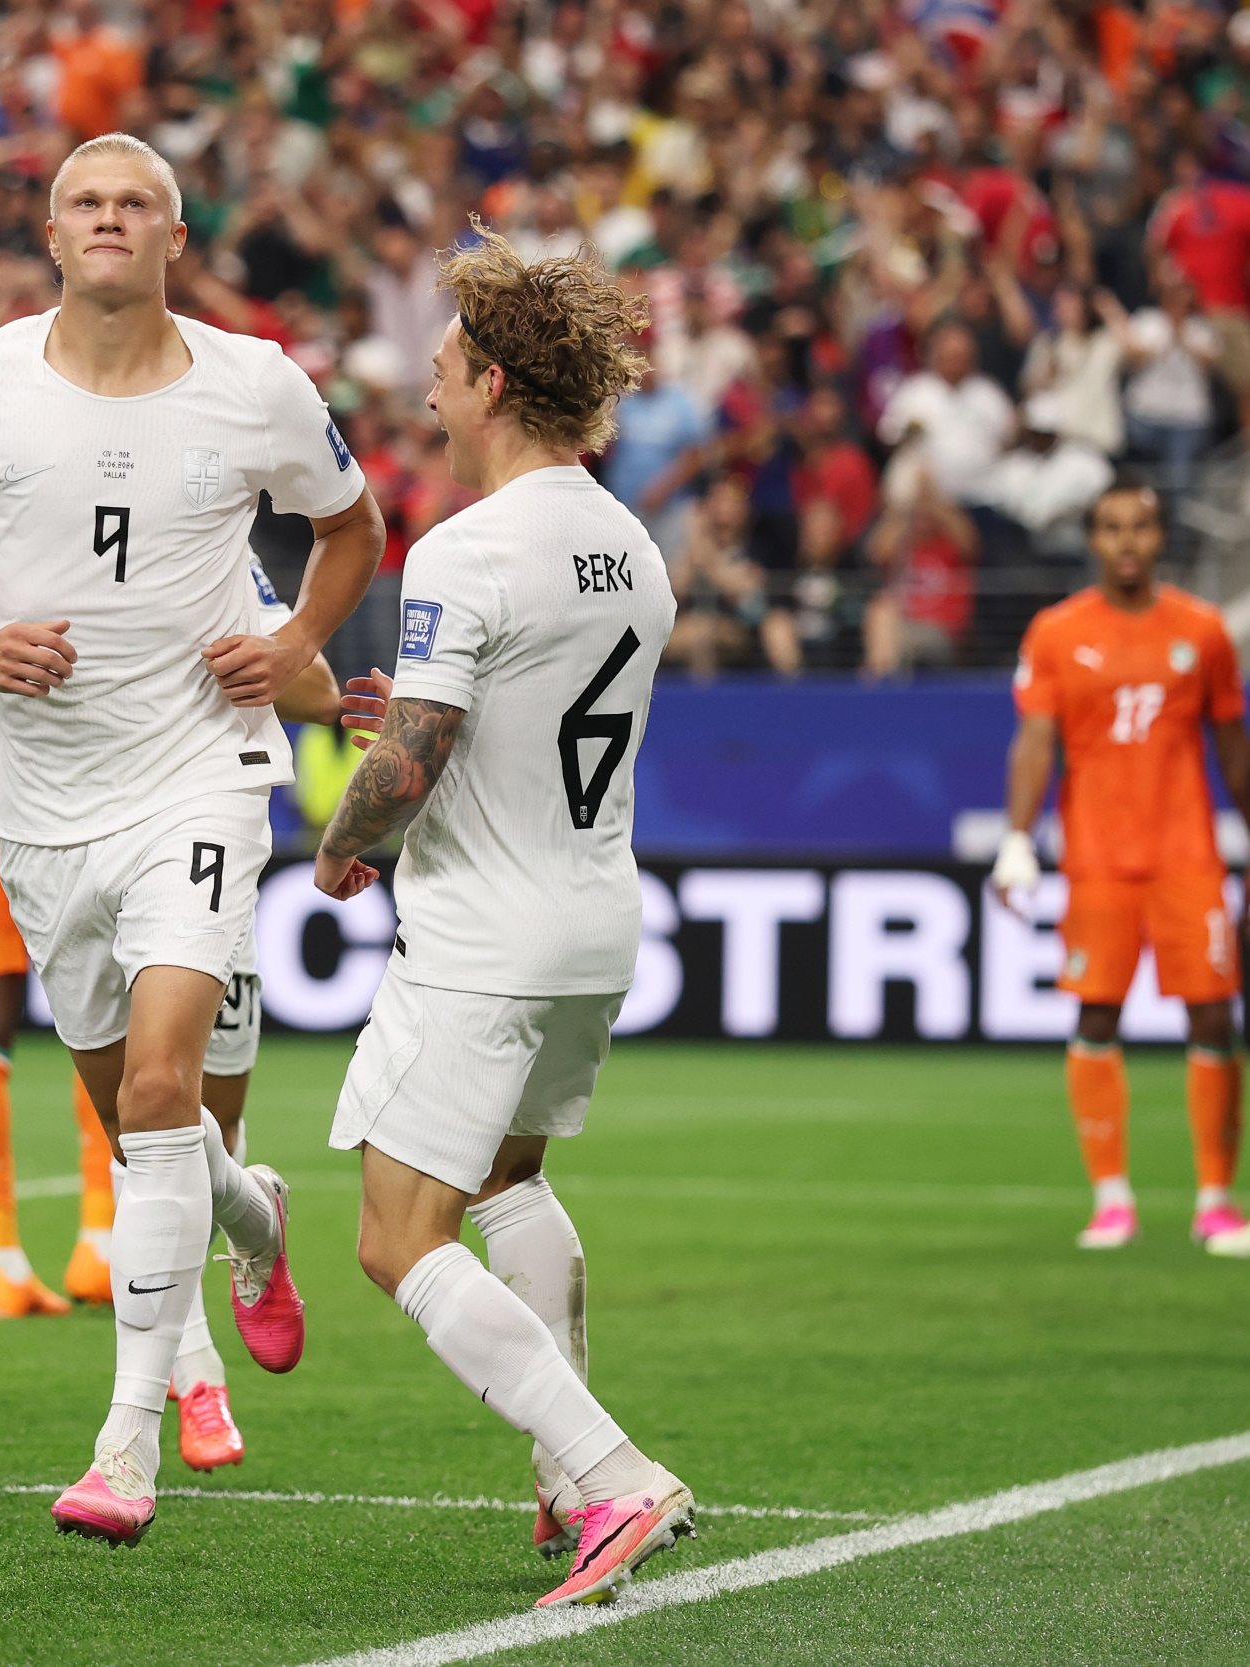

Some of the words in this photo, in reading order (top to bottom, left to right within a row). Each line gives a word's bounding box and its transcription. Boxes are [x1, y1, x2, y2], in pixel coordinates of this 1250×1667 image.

[93, 505, 131, 583] 9
[573, 551, 633, 594] BERG
[557, 624, 642, 830] 6
[189, 841, 226, 914] 9
